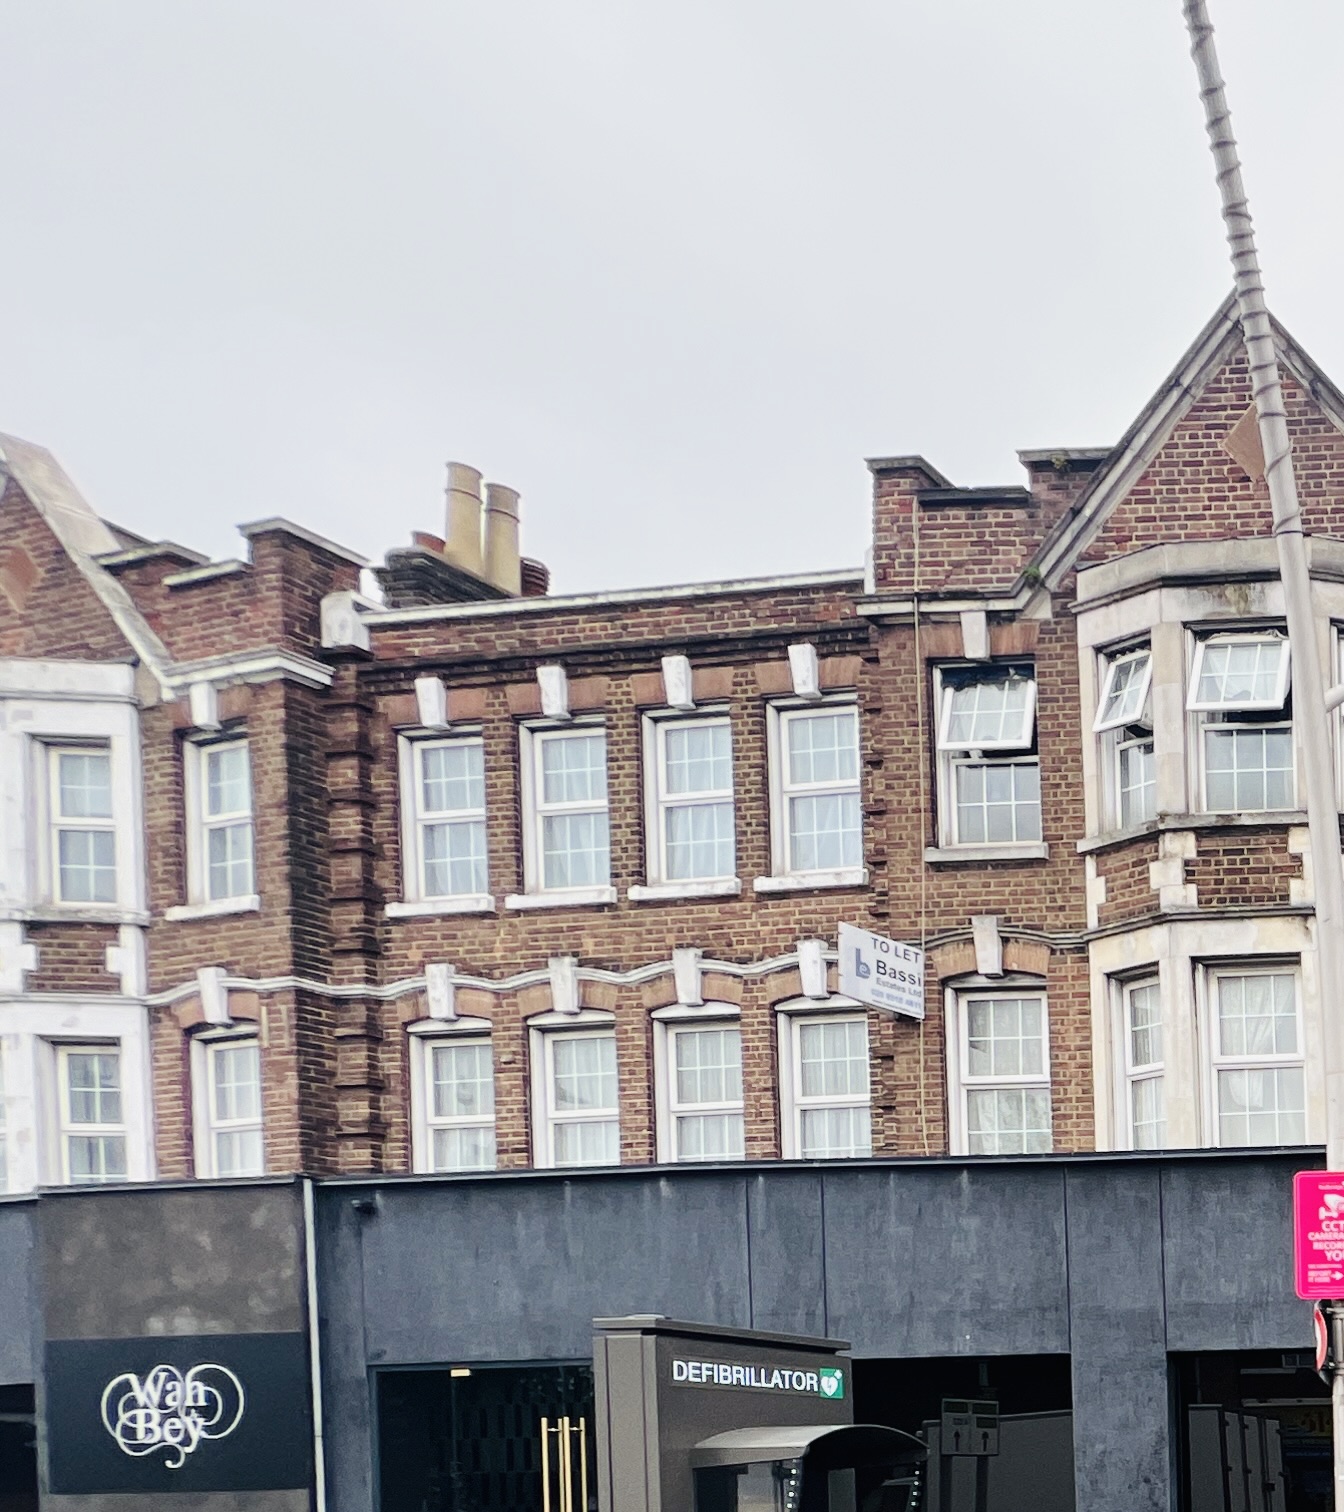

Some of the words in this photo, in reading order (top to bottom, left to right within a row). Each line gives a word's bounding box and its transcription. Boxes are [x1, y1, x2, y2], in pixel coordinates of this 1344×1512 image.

[871, 937, 890, 954] TO
[894, 945, 921, 964] LET
[876, 959, 921, 987] Bassi
[672, 1359, 819, 1393] DEFIBRILLATOR
